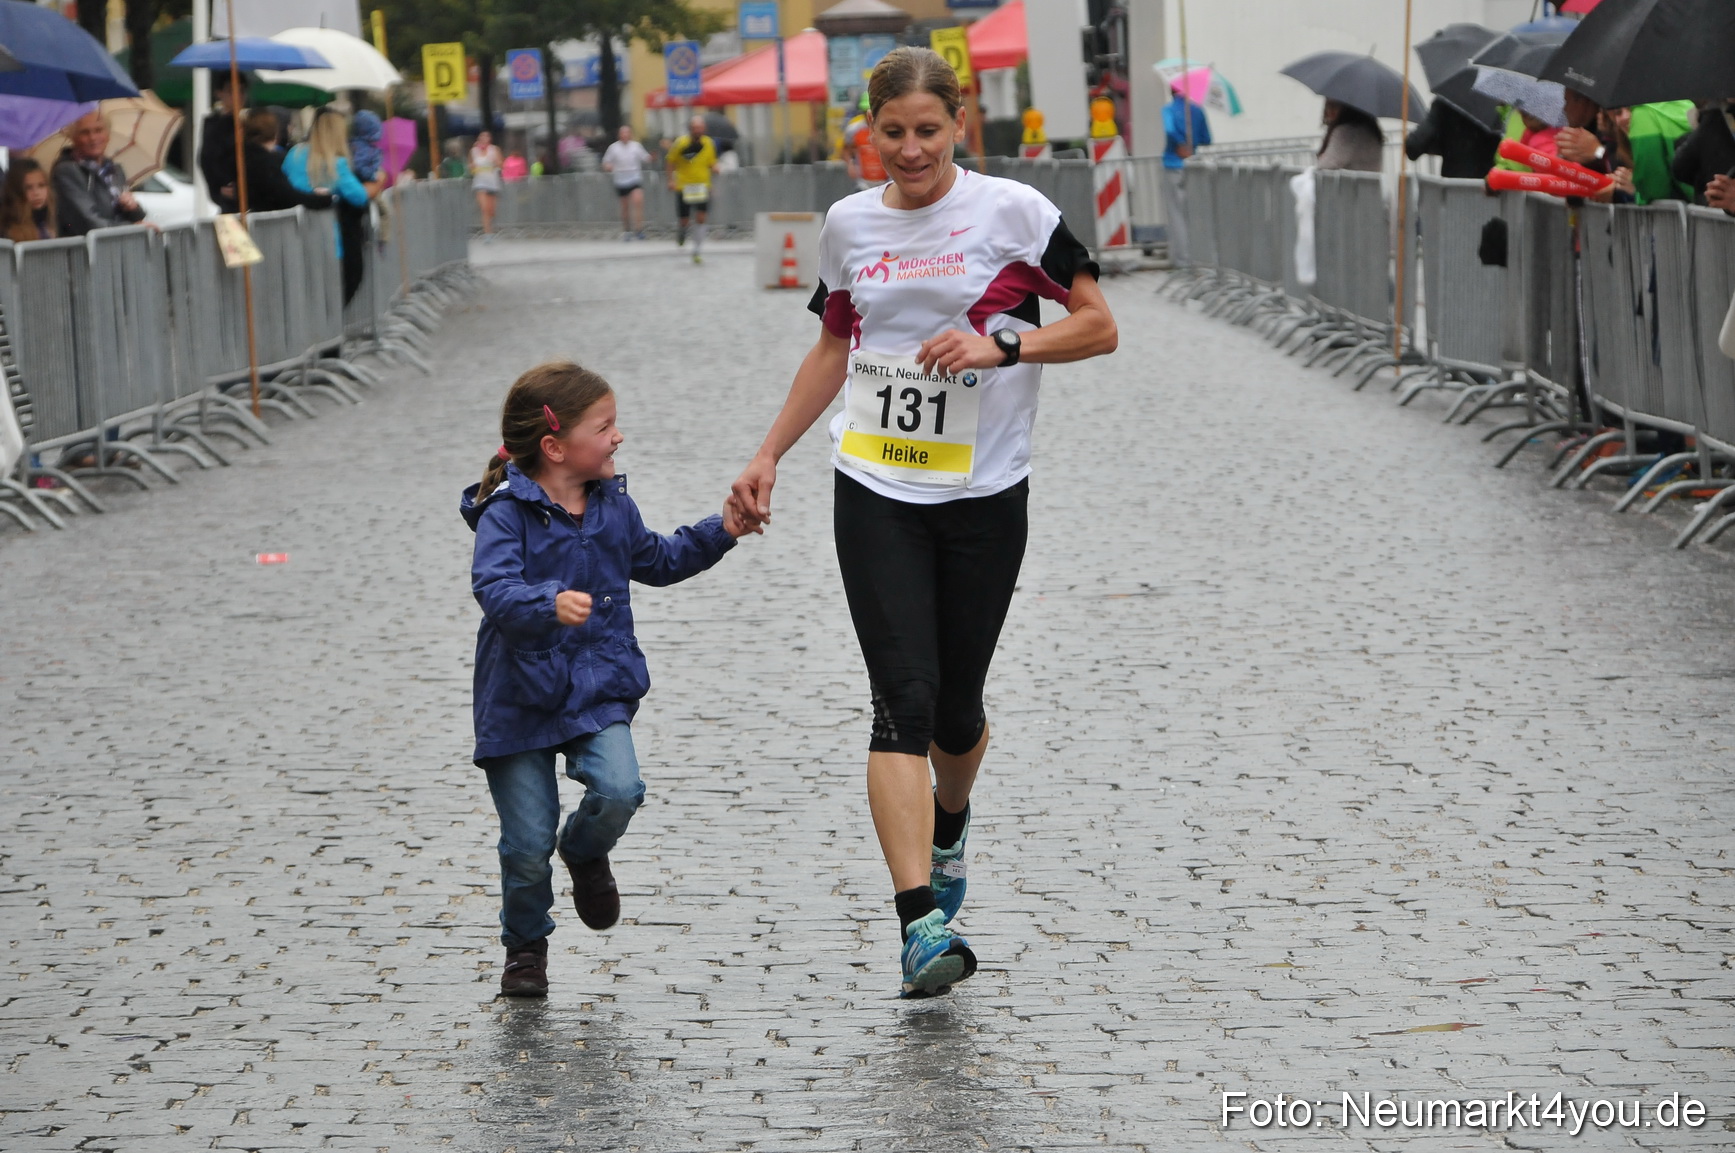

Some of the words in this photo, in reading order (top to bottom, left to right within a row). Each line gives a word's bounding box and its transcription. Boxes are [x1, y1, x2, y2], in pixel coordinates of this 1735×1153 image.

[434, 60, 452, 88] D
[898, 252, 964, 270] MÜNCHEN
[896, 265, 966, 280] MARATHON
[854, 362, 893, 378] PARTL
[876, 385, 948, 435] 131
[882, 443, 929, 465] Heike
